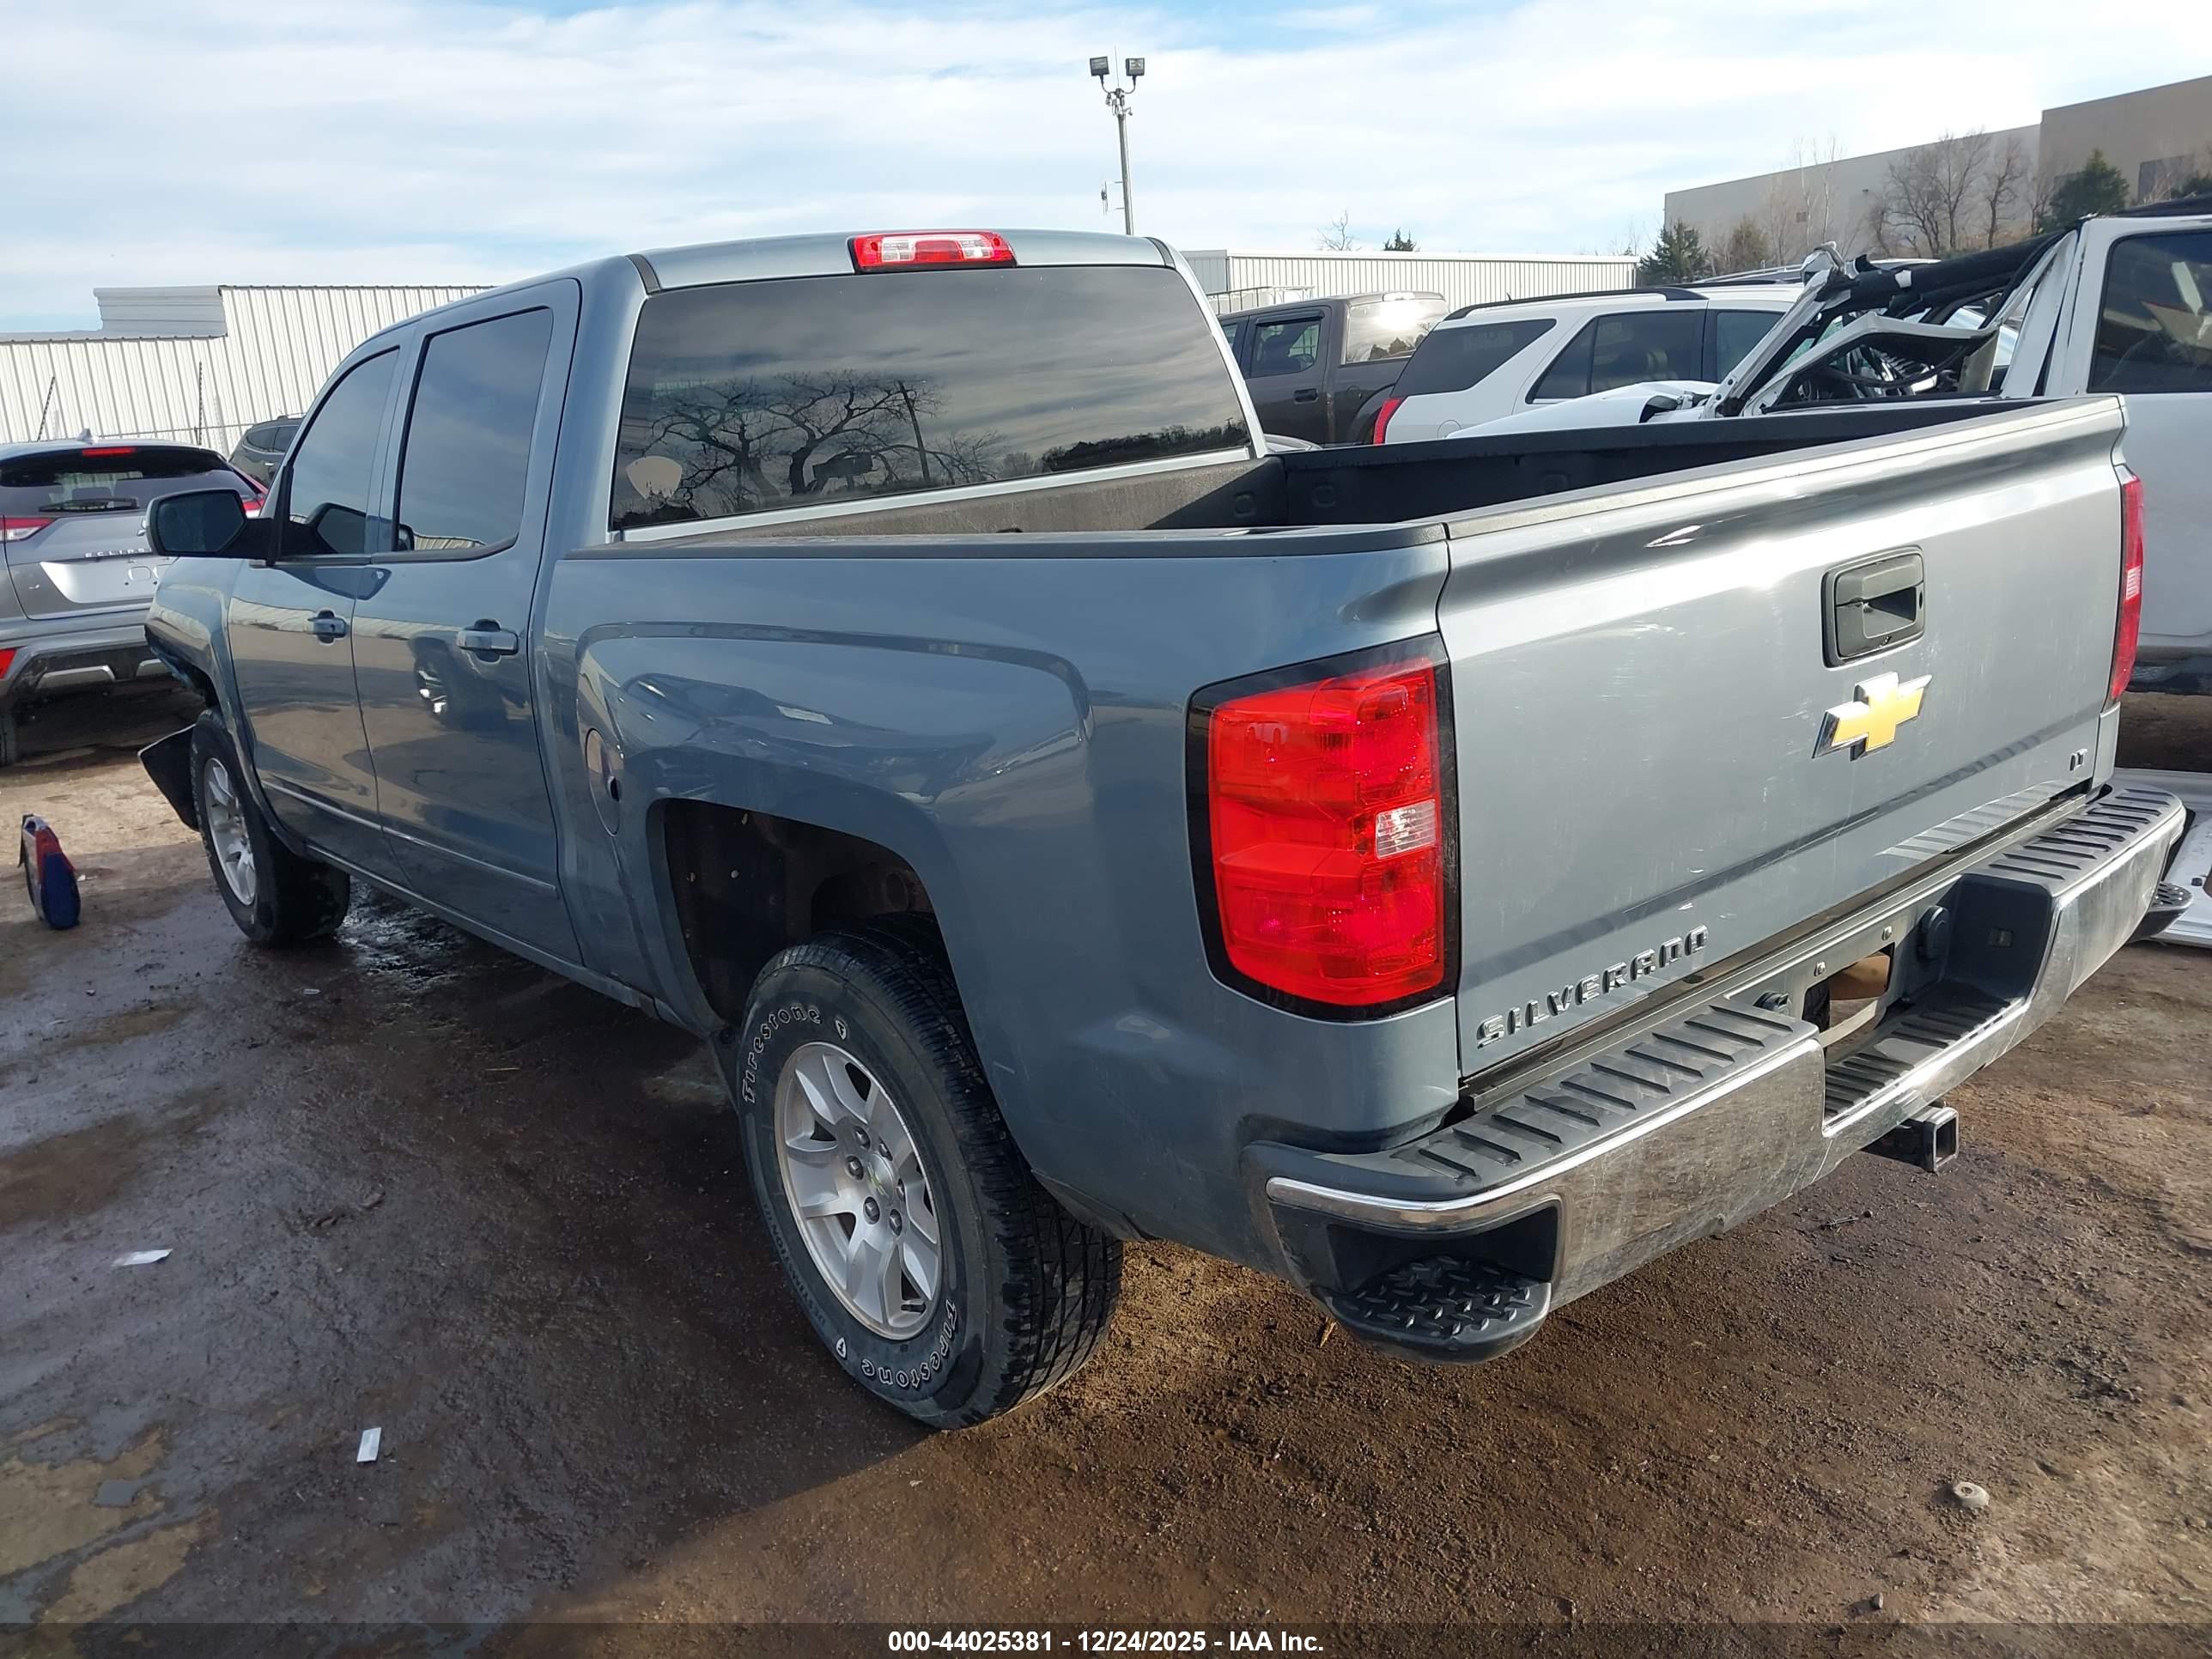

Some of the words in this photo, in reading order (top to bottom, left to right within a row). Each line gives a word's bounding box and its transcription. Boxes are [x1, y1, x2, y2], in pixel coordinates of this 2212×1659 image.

[2069, 747, 2088, 773] LT
[1476, 924, 1709, 1050] SILVERADO
[741, 1006, 822, 1104] Firestone
[860, 1298, 958, 1389] Firestone
